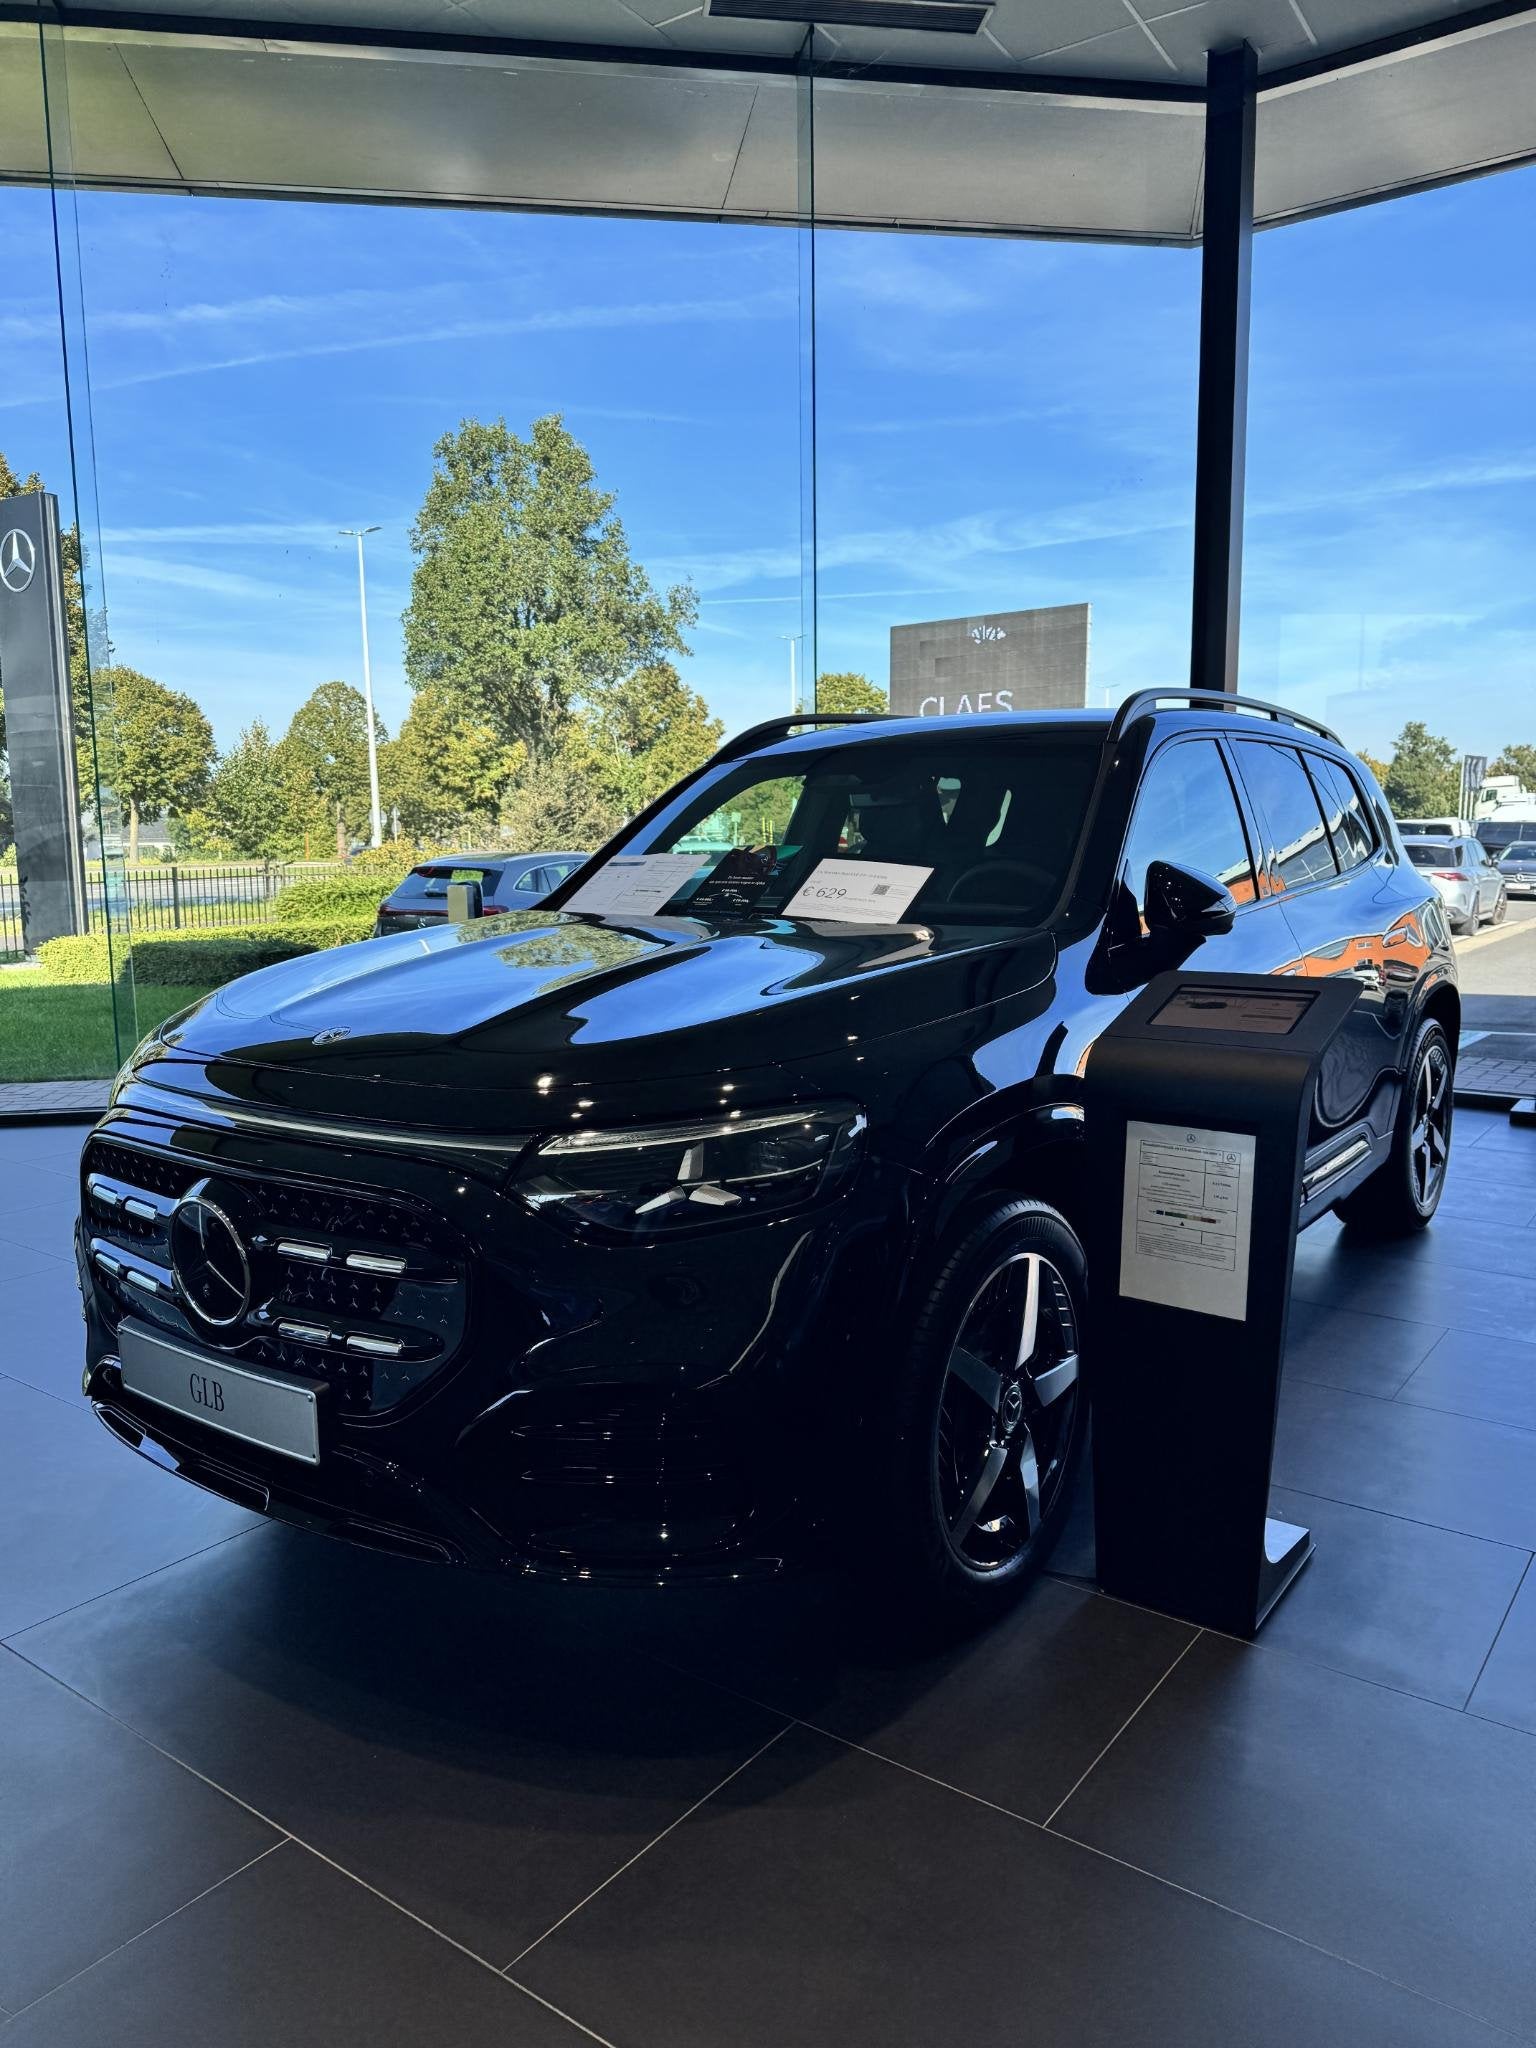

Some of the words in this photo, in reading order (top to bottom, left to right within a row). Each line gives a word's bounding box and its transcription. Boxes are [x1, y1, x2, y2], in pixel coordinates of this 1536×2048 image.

[919, 690, 1014, 718] CLAES
[816, 887, 848, 899] 629
[190, 1373, 225, 1412] GLB
